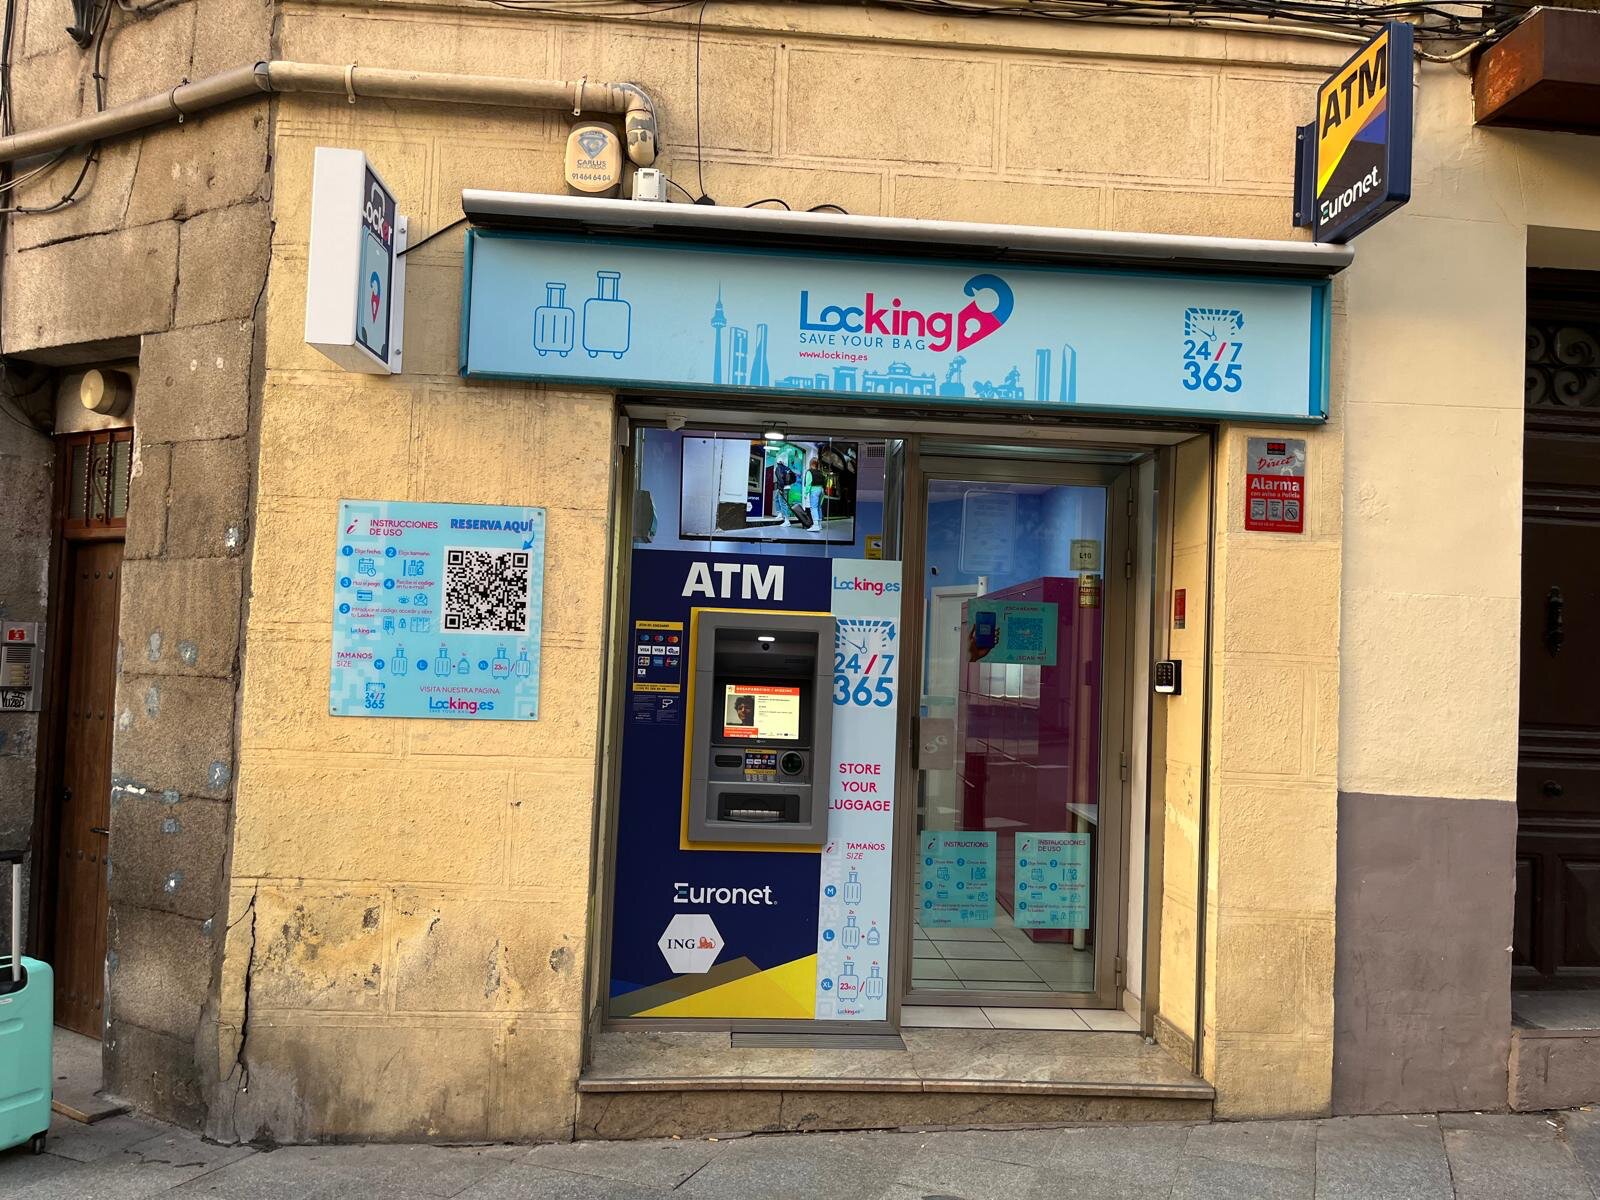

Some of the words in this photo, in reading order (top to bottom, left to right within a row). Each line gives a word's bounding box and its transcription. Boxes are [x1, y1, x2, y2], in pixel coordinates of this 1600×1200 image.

[1321, 43, 1387, 140] ATM
[1320, 165, 1379, 226] Euronet
[800, 290, 952, 353] Locking
[800, 332, 836, 345] SAVE
[842, 335, 883, 348] YOUR
[892, 339, 926, 351] BAG
[799, 350, 868, 363] www.locking.es
[1183, 340, 1243, 362] 24/7
[1183, 360, 1242, 393] 365
[1257, 455, 1295, 470] Direct
[1251, 477, 1300, 491] Alarma
[370, 520, 438, 529] INSTRUCCIONES
[450, 519, 501, 531] RESERVA
[503, 518, 535, 533] AQUÍ
[383, 529, 402, 537] USO
[682, 562, 785, 600] ATM
[834, 577, 900, 596] Locking.es
[336, 661, 352, 669] SIZE
[834, 653, 895, 675] 24/7
[365, 692, 385, 700] 24/7
[420, 686, 440, 694] VISITA
[442, 686, 473, 695] NUESTRA
[833, 675, 894, 707] 365
[365, 699, 385, 709] 365
[429, 697, 494, 713] Locking.es
[839, 763, 881, 775] STORE
[841, 781, 877, 793] YOUR
[847, 852, 864, 861] SIZE
[673, 882, 774, 905] Euronet
[668, 938, 695, 950] ING
